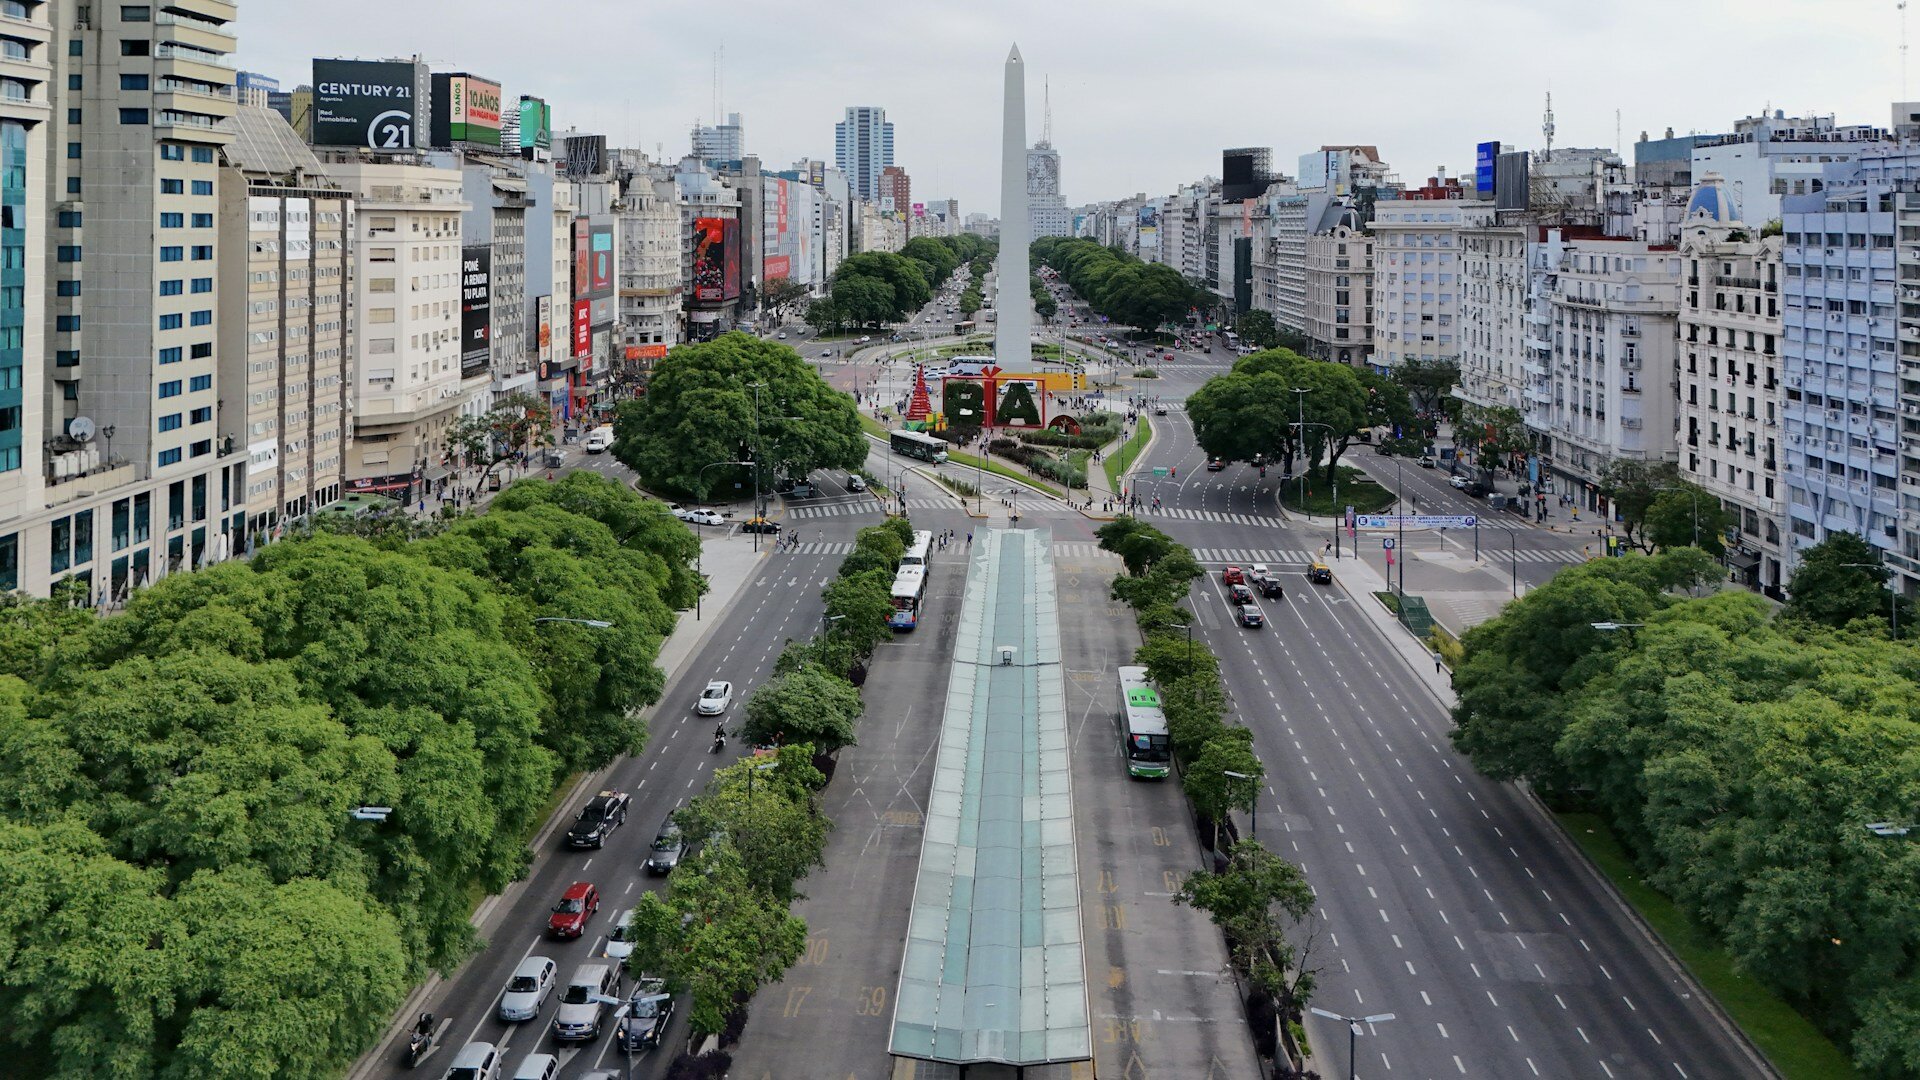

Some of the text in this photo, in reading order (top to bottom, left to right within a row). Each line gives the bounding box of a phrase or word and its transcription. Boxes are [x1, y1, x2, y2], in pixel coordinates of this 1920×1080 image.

[319, 83, 392, 97] CENTURY
[470, 90, 499, 113] 10 AÑOS
[464, 259, 479, 272] PONÉ
[464, 273, 488, 286] A RENDIR
[464, 287, 487, 300] TU PLATA
